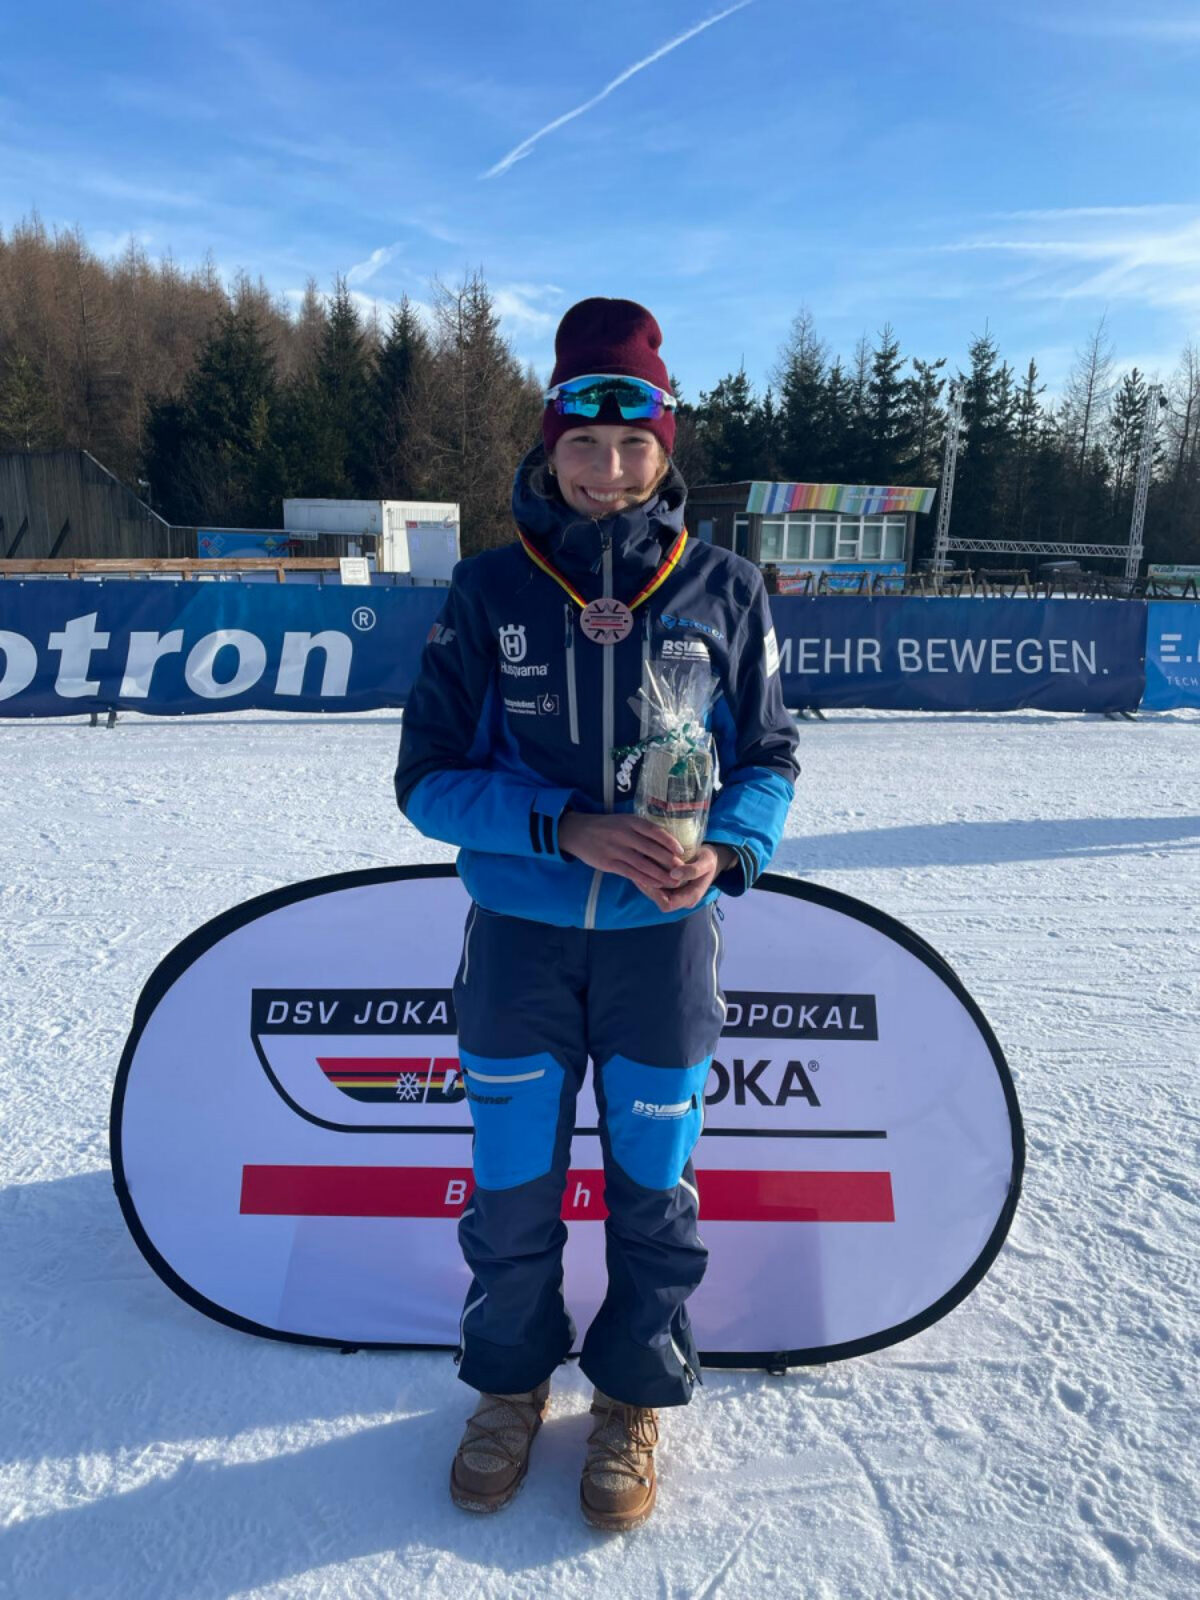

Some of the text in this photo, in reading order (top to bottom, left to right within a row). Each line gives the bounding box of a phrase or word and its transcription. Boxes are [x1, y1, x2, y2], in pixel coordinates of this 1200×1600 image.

[898, 638, 1110, 675] BEWEGEN.
[501, 661, 549, 679] Husqvarna
[266, 1000, 339, 1025] DSV
[353, 1000, 449, 1025] JOKA
